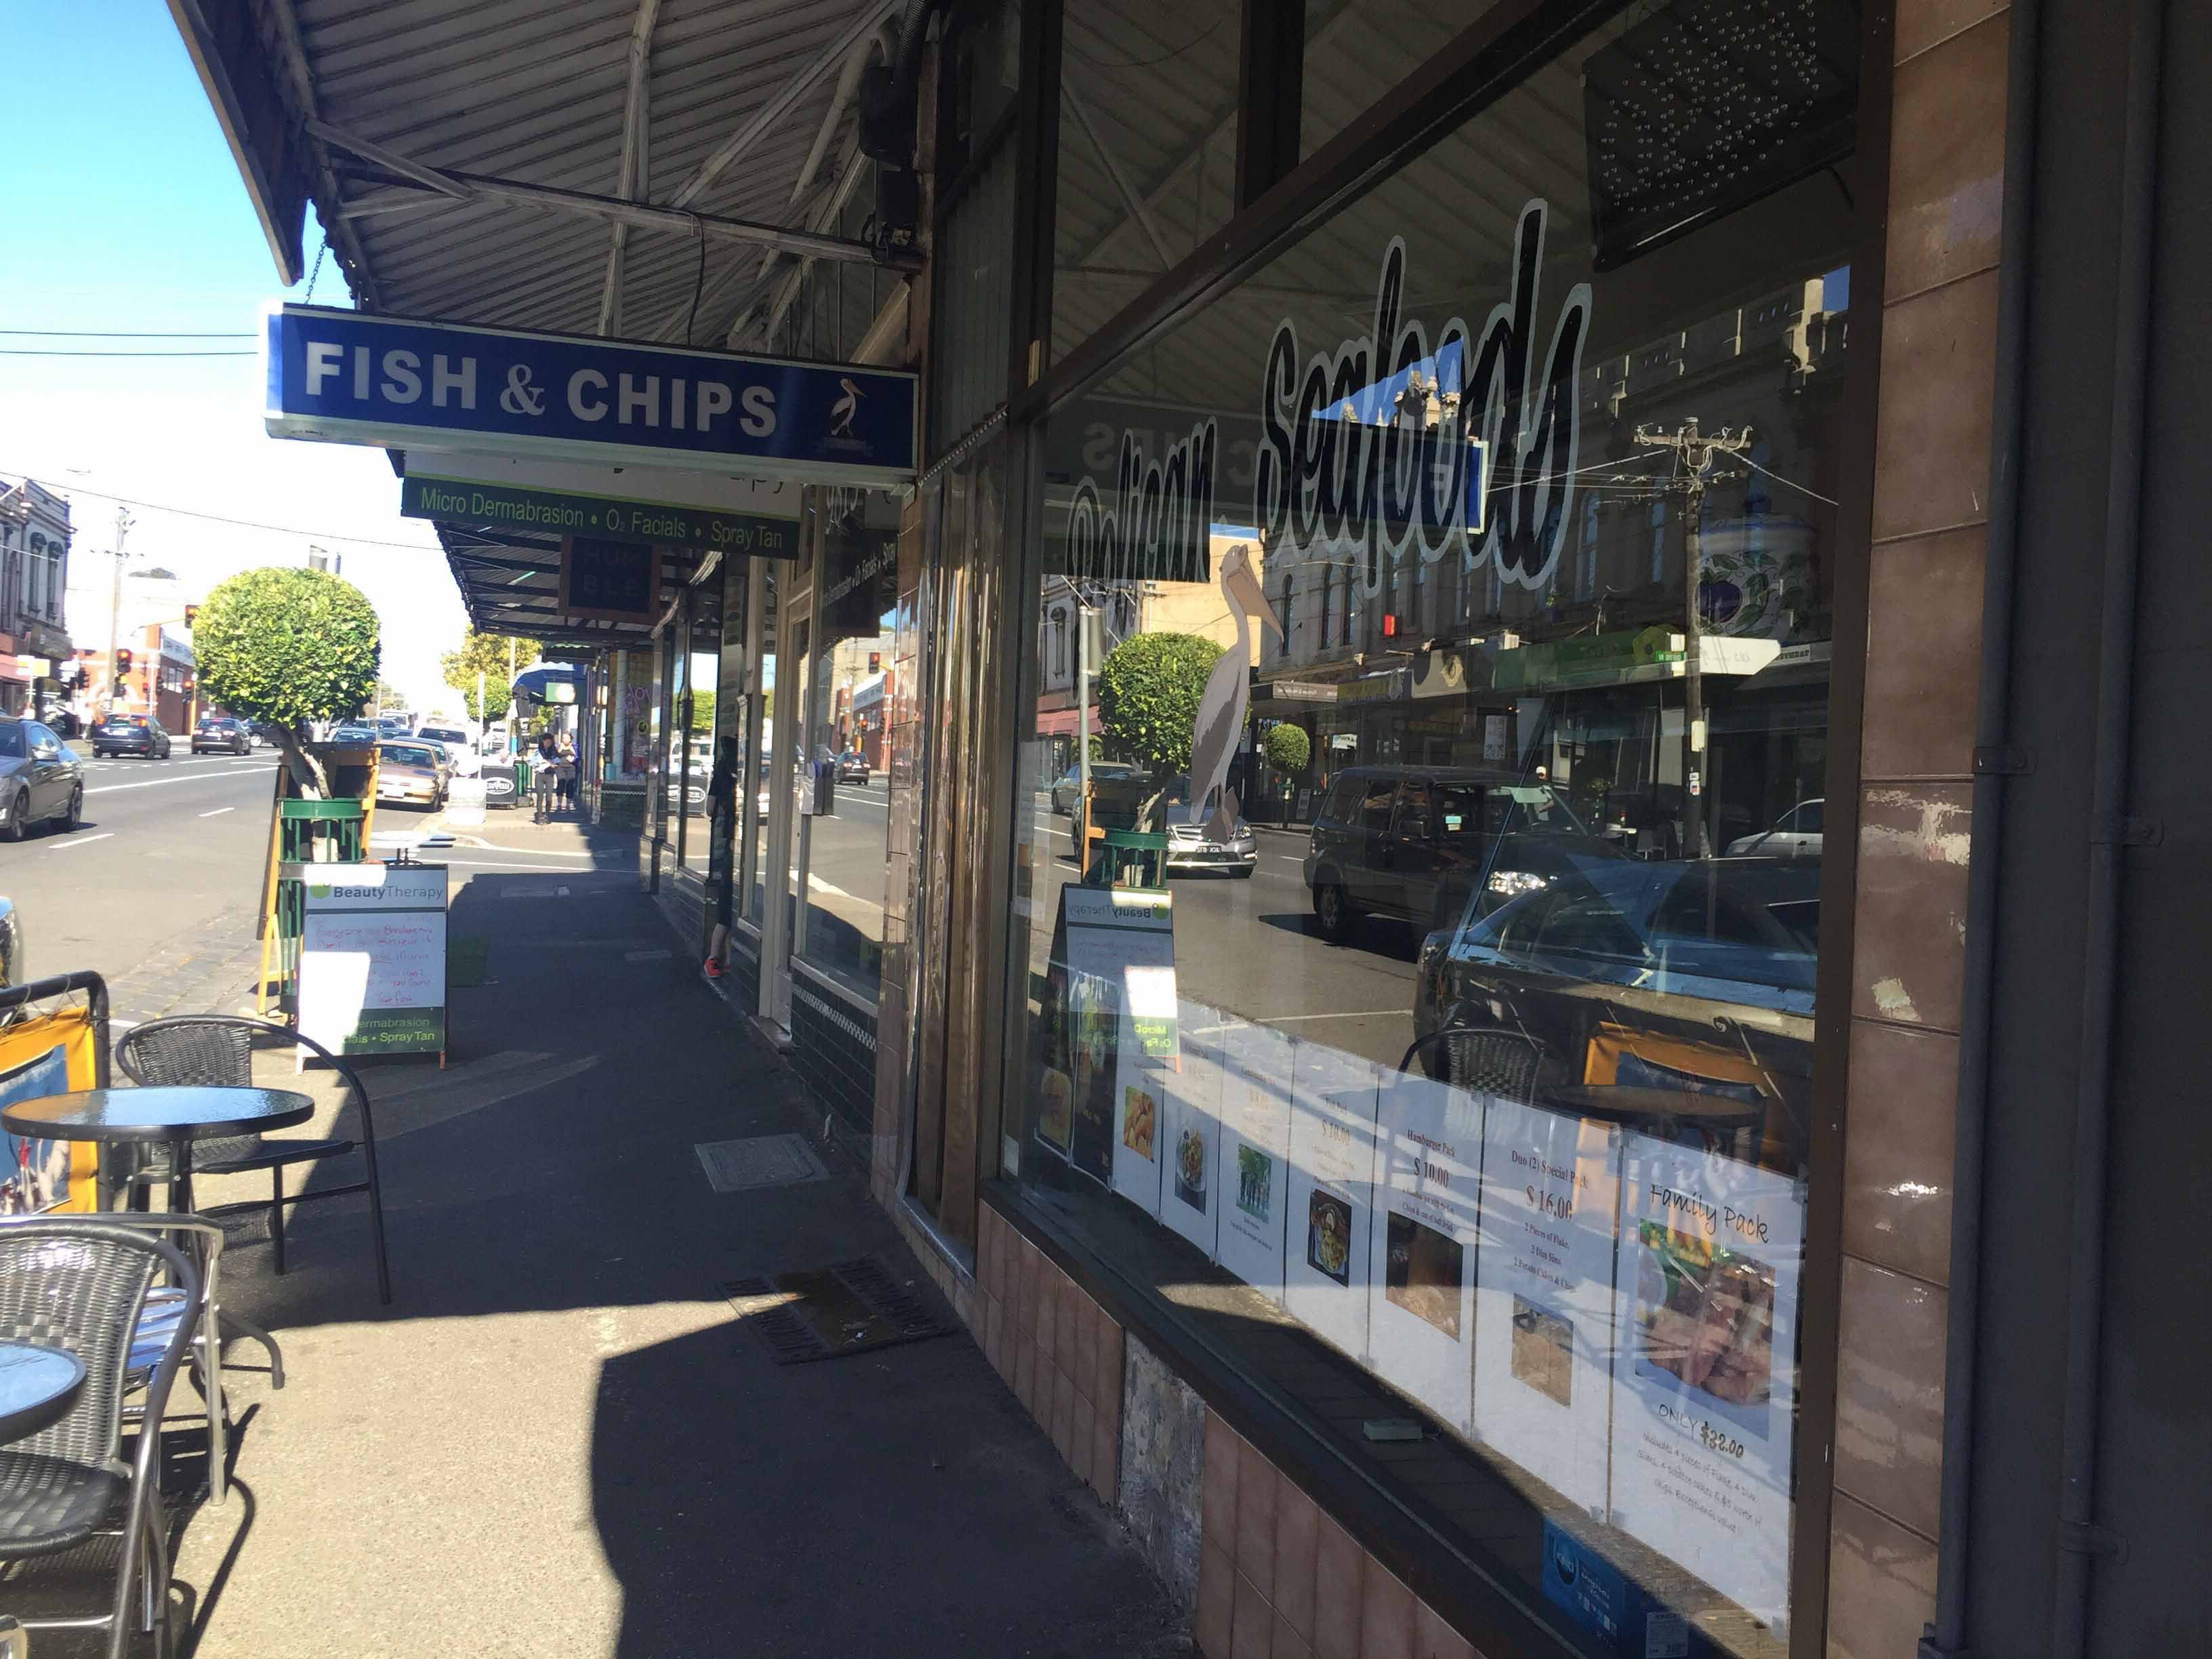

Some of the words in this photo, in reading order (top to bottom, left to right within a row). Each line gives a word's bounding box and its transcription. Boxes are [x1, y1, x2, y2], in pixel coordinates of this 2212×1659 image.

[304, 341, 477, 411] FISH
[499, 363, 546, 417] &
[566, 368, 777, 438] CHIPS
[421, 487, 466, 514] Micro
[472, 493, 584, 527] Dermabrasion
[632, 512, 686, 538] Facials
[711, 520, 754, 550] Spray
[756, 525, 783, 548] Tan
[356, 1017, 430, 1029] ermabrasion
[379, 1033, 415, 1044] Spray
[415, 1031, 434, 1042] Tan
[1407, 1128, 1441, 1152] Hamburger
[1414, 1157, 1421, 1176] $
[1423, 1160, 1449, 1188] 10.00
[1512, 1149, 1528, 1166] Duo
[1528, 1157, 1540, 1172] (2)
[1541, 1161, 1568, 1181] Special
[1526, 1185, 1534, 1207] $
[1538, 1189, 1573, 1221] 16.00
[1650, 1183, 1717, 1235] Family
[1723, 1206, 1769, 1244] Pack
[1530, 1224, 1546, 1239] Pieces
[1659, 1404, 1698, 1440] ONLY
[1700, 1420, 1745, 1458] $32.00
